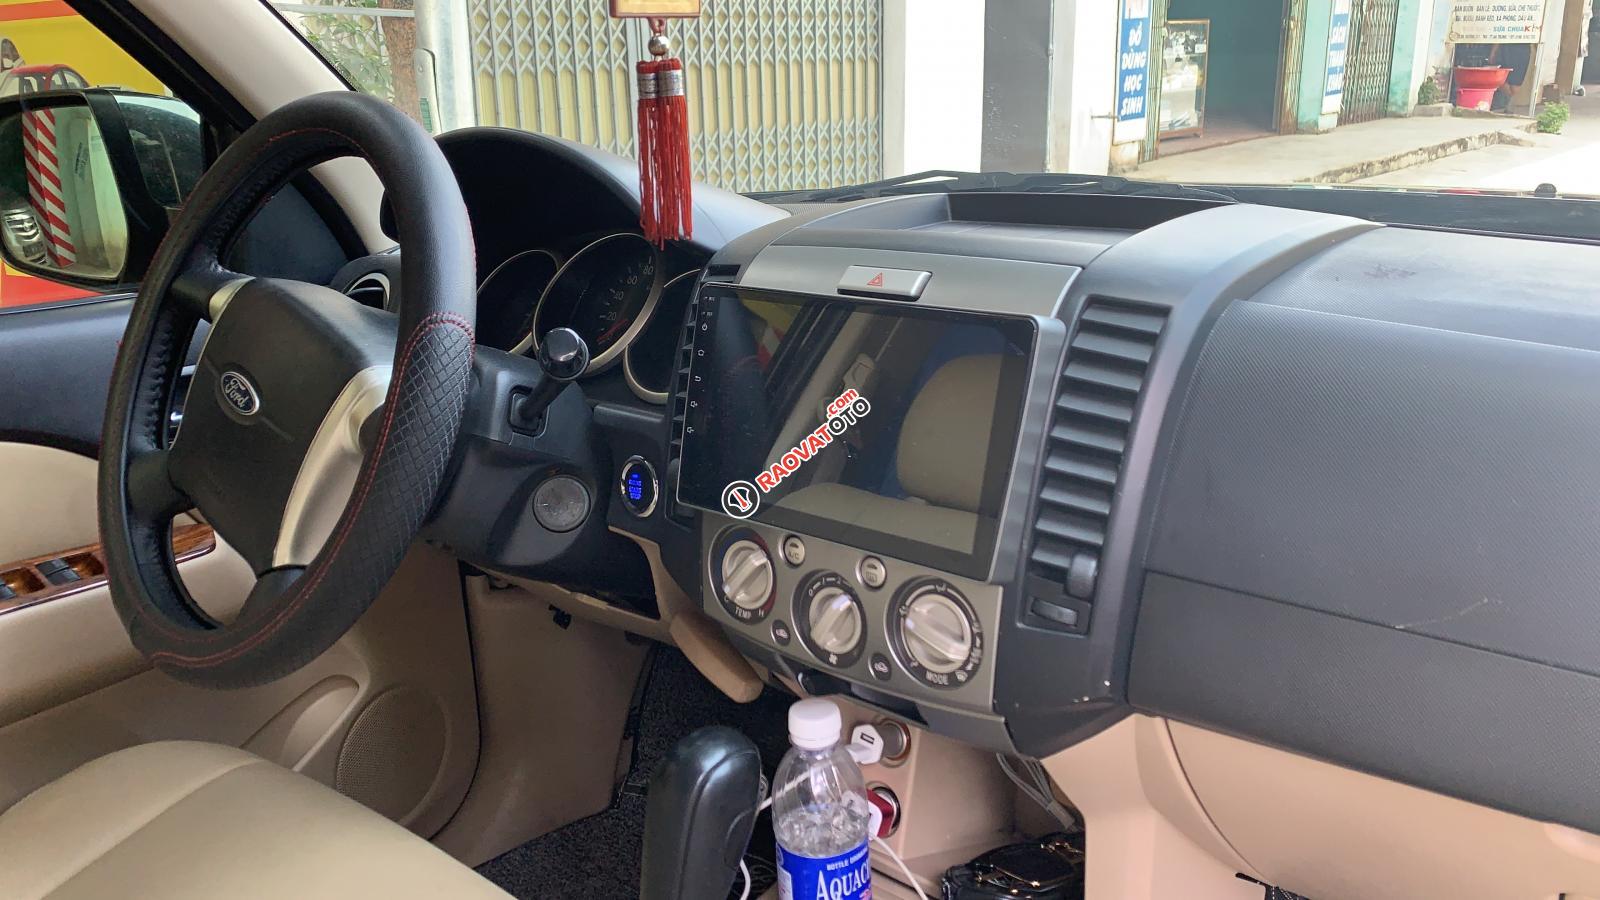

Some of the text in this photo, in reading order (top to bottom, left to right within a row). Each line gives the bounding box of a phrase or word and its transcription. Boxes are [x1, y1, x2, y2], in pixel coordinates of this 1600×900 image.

[1121, 48, 1147, 71] DÙNG
[1123, 74, 1143, 96] HỌC
[1120, 96, 1144, 116] SINH
[225, 378, 249, 407] Ford
[735, 607, 752, 619] TEMP
[926, 670, 949, 685] MODE
